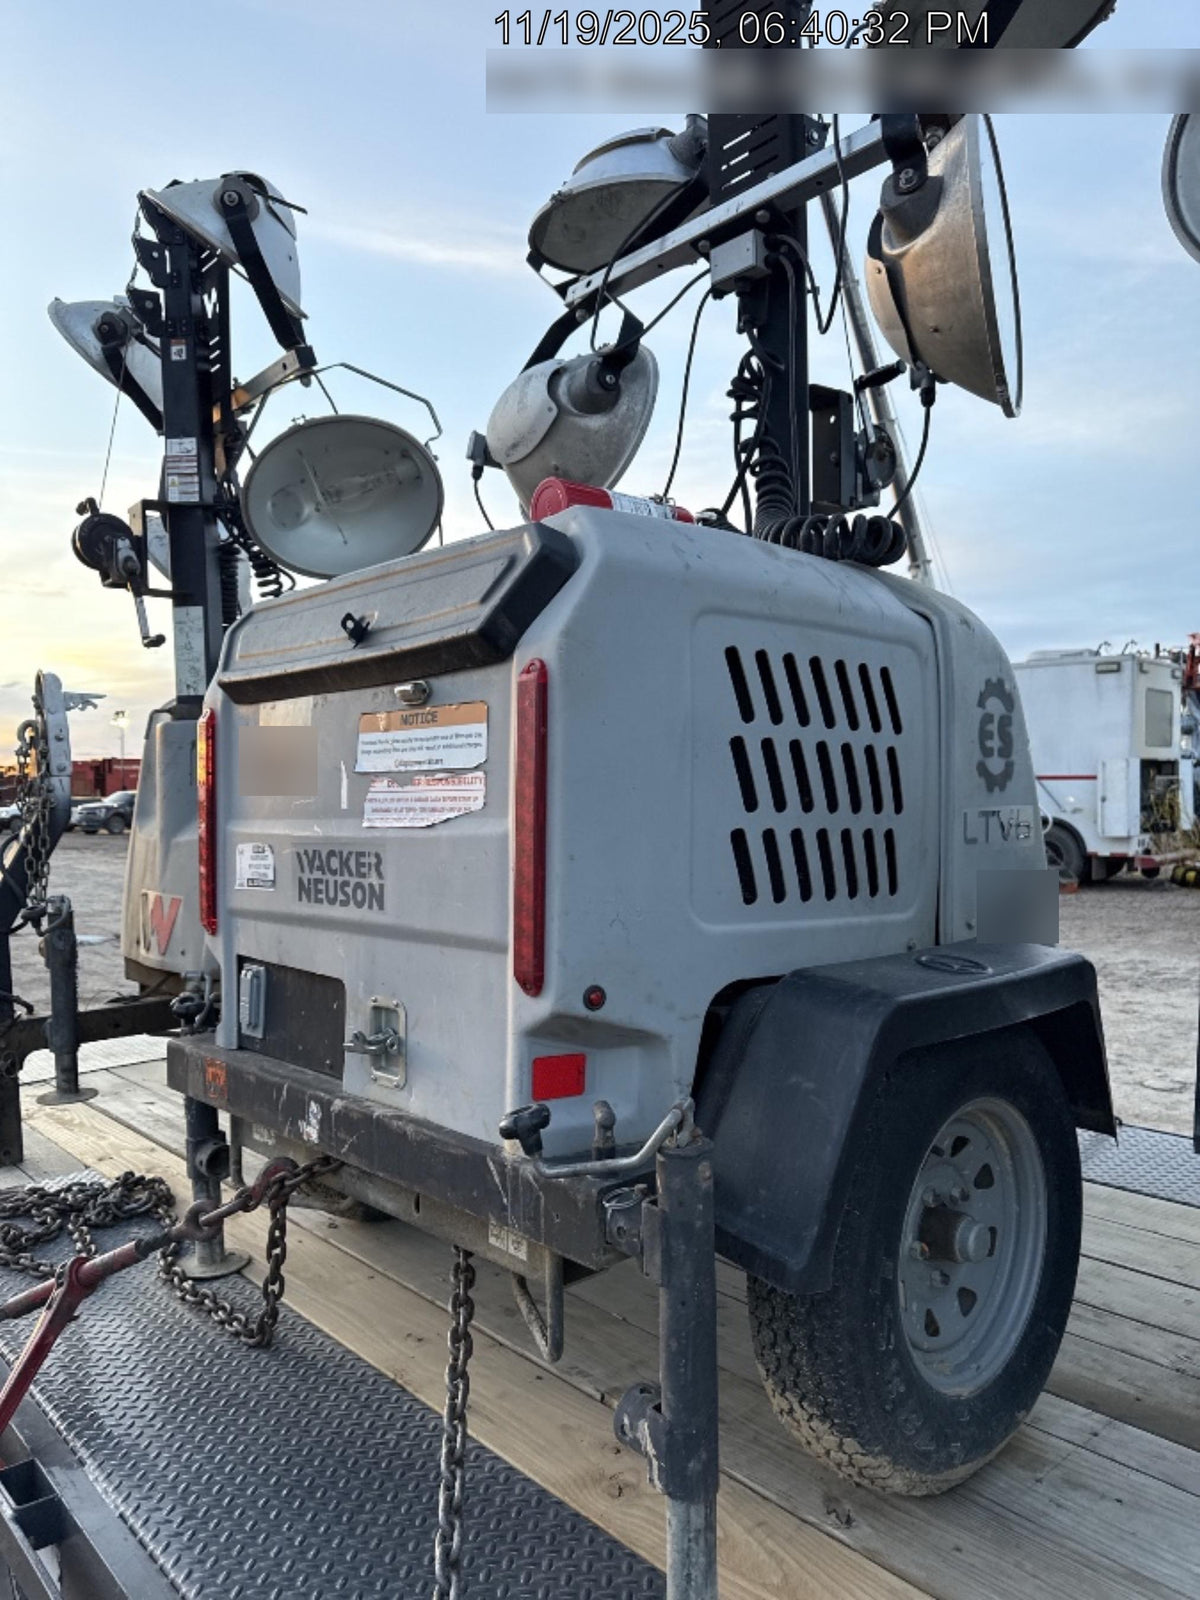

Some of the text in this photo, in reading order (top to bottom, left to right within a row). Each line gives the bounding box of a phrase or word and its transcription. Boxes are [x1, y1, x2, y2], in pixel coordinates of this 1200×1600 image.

[401, 711, 438, 726] NOTICE
[296, 849, 385, 882] WACKER
[298, 876, 385, 911] NEUSON
